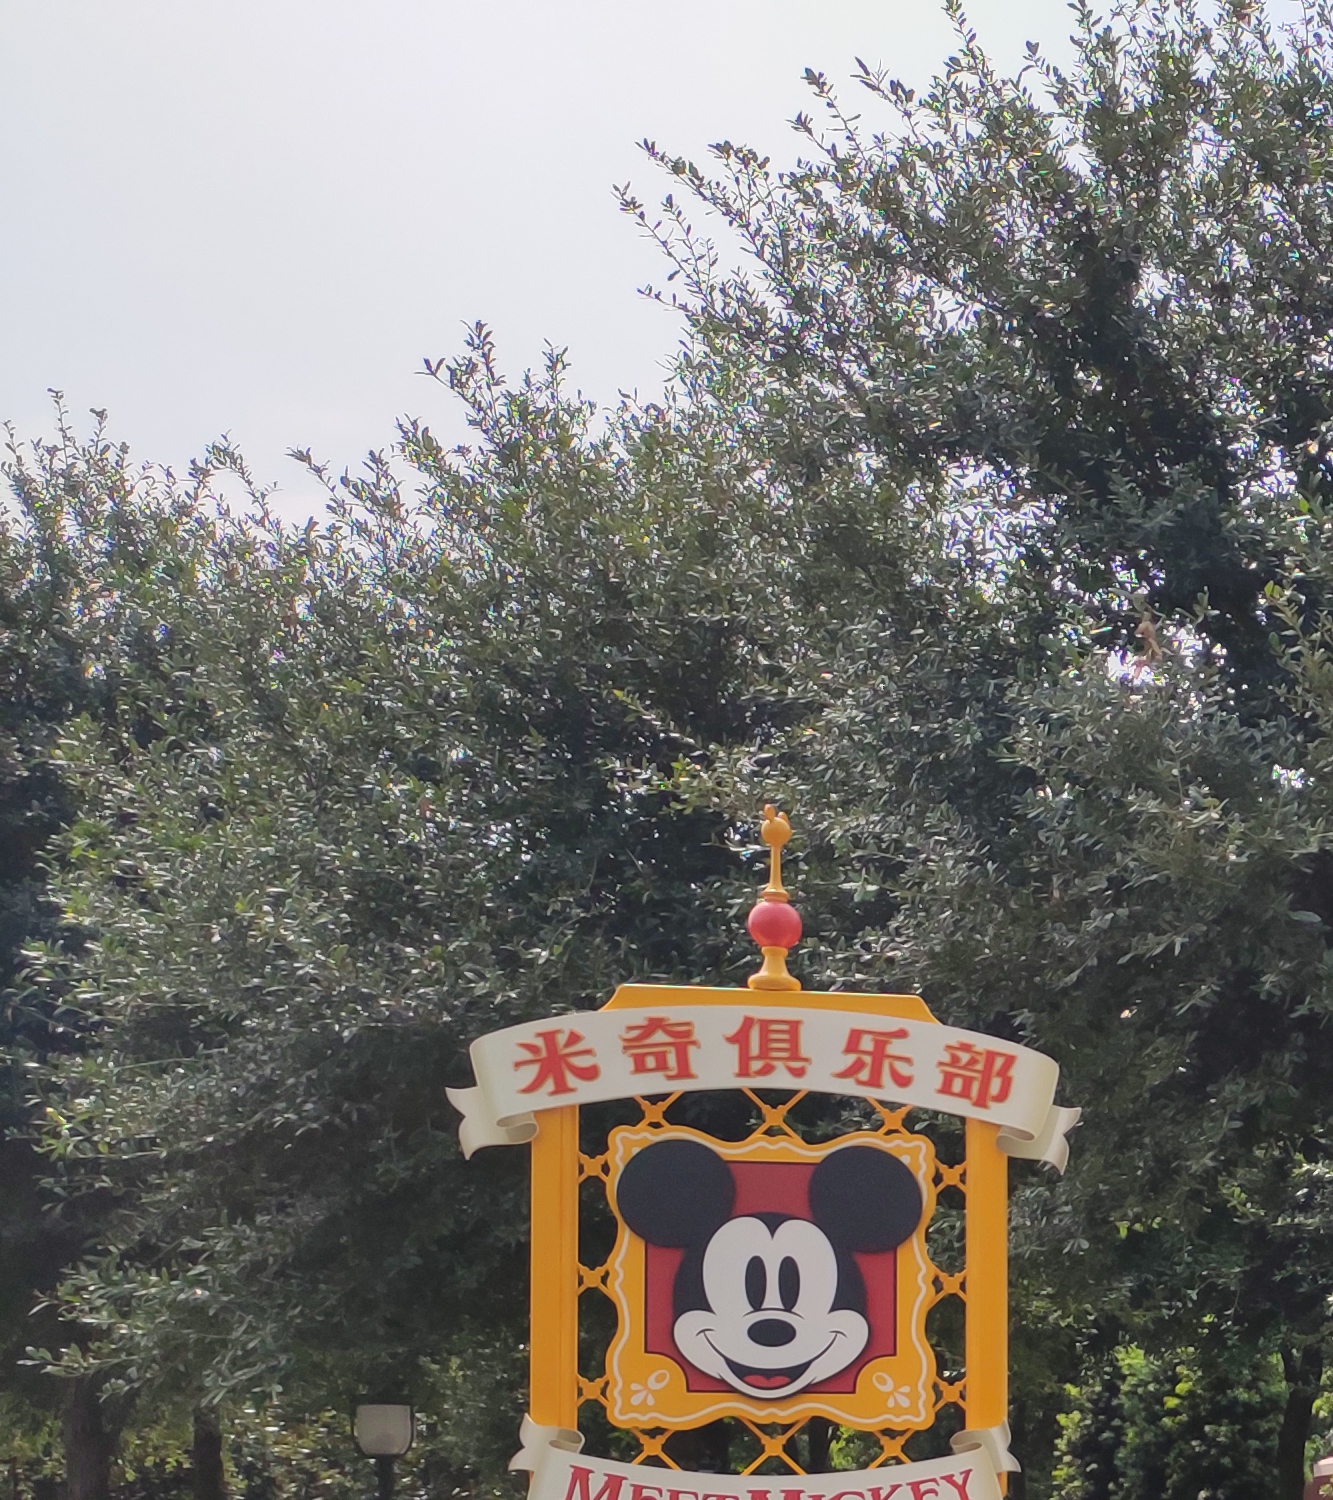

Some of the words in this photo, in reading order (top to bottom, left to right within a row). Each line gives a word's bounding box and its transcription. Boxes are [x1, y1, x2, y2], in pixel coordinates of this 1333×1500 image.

[513, 1015, 1018, 1109] 米奇俱乐部
